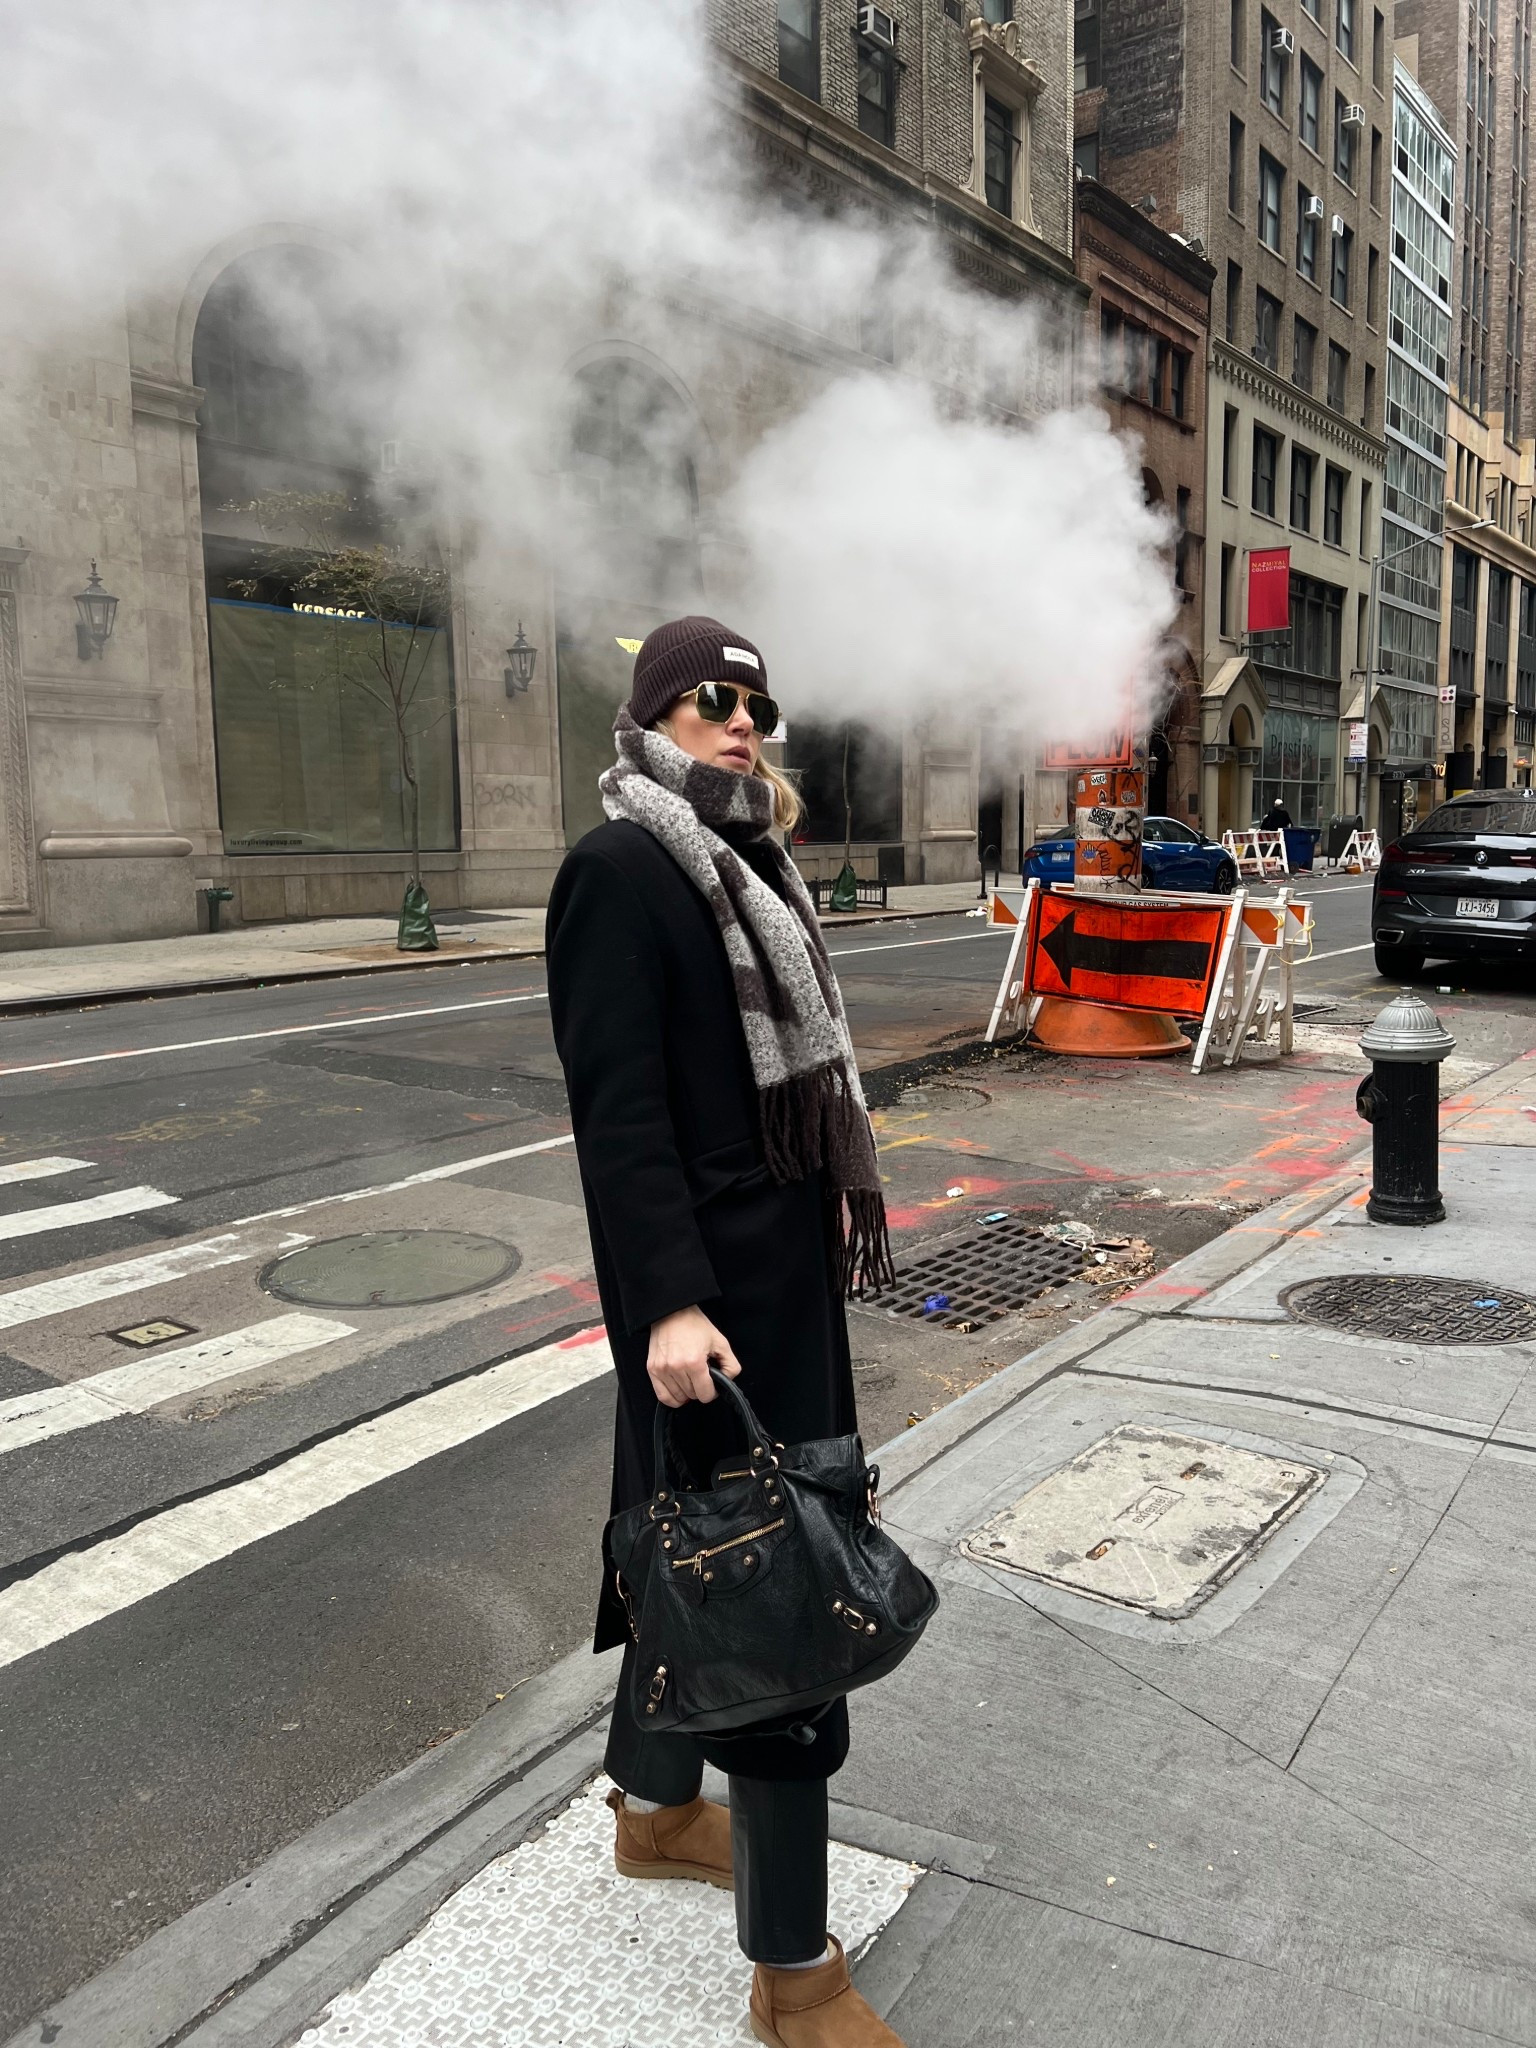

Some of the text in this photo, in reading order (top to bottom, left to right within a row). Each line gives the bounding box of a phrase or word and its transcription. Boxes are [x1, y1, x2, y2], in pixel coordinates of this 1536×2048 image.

[1252, 565, 1287, 573] COLLECTION
[1271, 734, 1312, 762] Prestige
[229, 838, 303, 847] luxurylivinggroup.com
